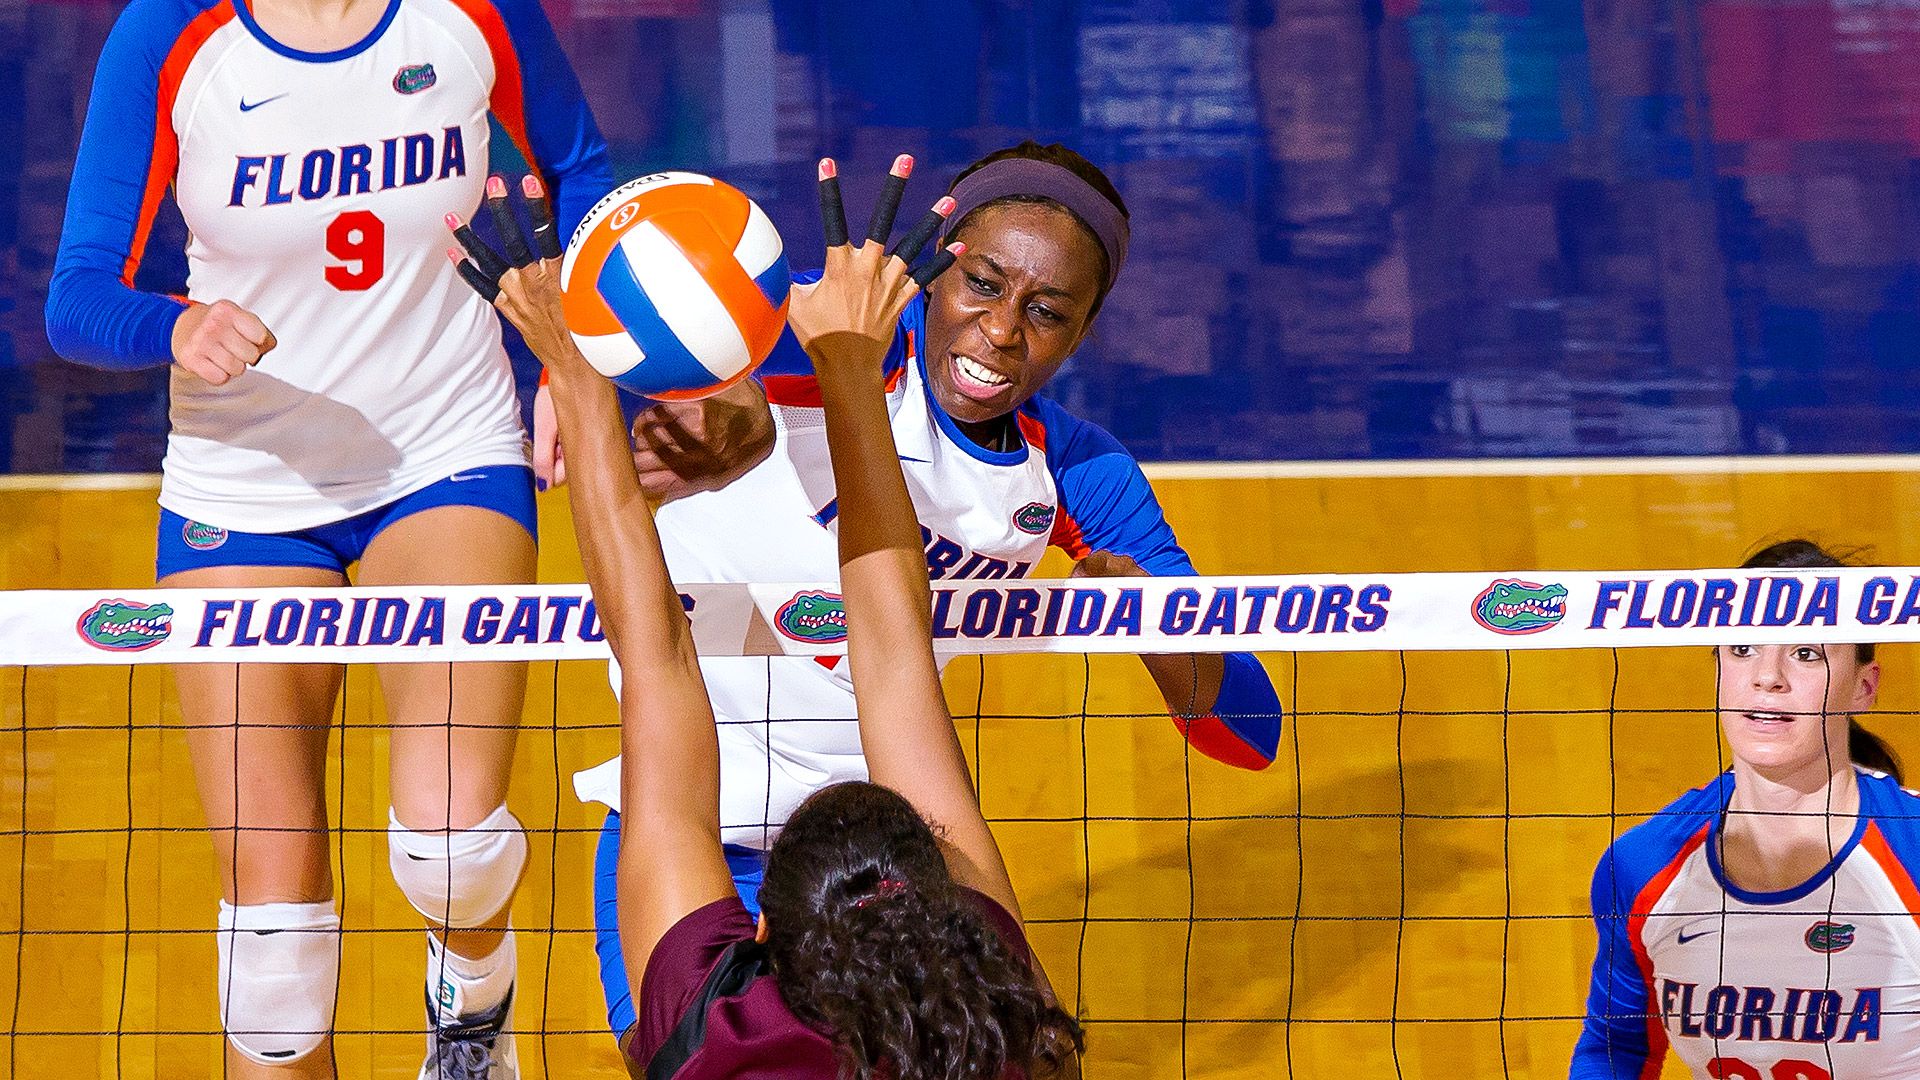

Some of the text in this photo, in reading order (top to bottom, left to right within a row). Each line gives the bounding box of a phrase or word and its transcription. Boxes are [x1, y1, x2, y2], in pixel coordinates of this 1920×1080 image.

[226, 125, 466, 207] FLORIDA
[324, 210, 385, 291] 9
[192, 595, 696, 647] FLORIDA GATO
[931, 583, 1391, 638] LORIDA GATORS
[1585, 576, 1840, 629] FLORIDA
[1662, 978, 1882, 1043] FLORIDA
